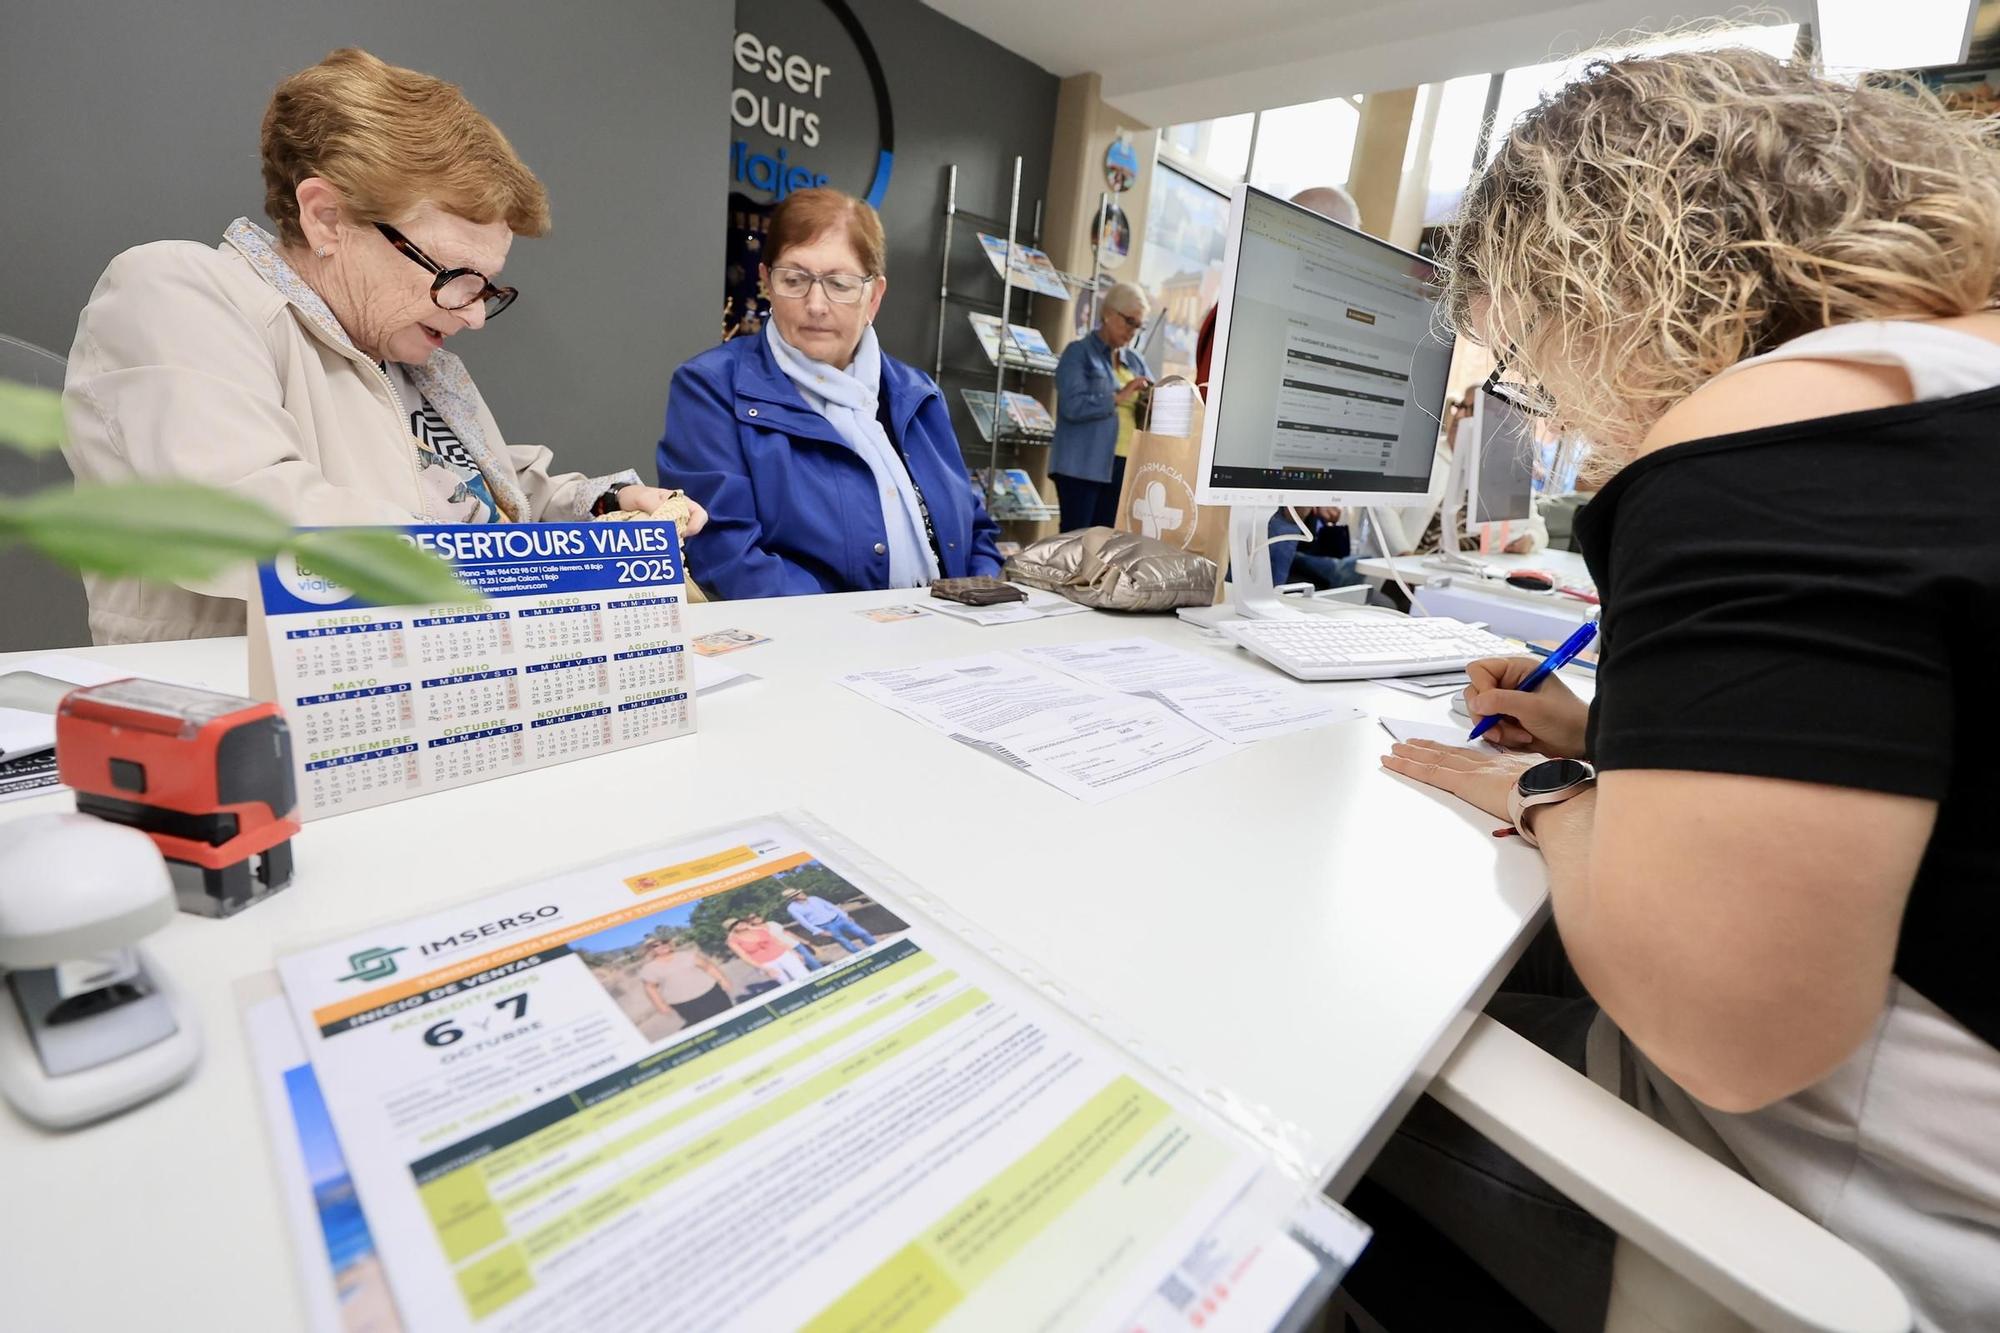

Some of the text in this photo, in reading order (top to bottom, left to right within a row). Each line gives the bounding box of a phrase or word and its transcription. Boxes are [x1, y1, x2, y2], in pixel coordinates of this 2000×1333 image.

[589, 528, 668, 553] VIAJES
[544, 573, 559, 581] Bajo
[615, 560, 675, 583] 2025
[430, 605, 492, 616] FEBRERO
[539, 598, 579, 606] MARZO
[317, 615, 371, 626] ENERO
[628, 640, 668, 650] AGOSTO
[550, 652, 582, 661] JULIO
[448, 664, 489, 675] JUNIO
[333, 679, 377, 690] MAYO
[625, 687, 679, 702] DICIEMBRE
[538, 701, 603, 718] NOVIEMBRE
[444, 719, 506, 736] OCTUBRE
[310, 736, 411, 760] SEPTIEMBRE
[420, 905, 560, 956] IMSERSO
[348, 954, 542, 1027] INICIO DE VENTAS
[388, 971, 541, 1033] ACREDITADOS
[423, 992, 529, 1047] 6 Y 7
[440, 1021, 543, 1064] OCTUBRE
